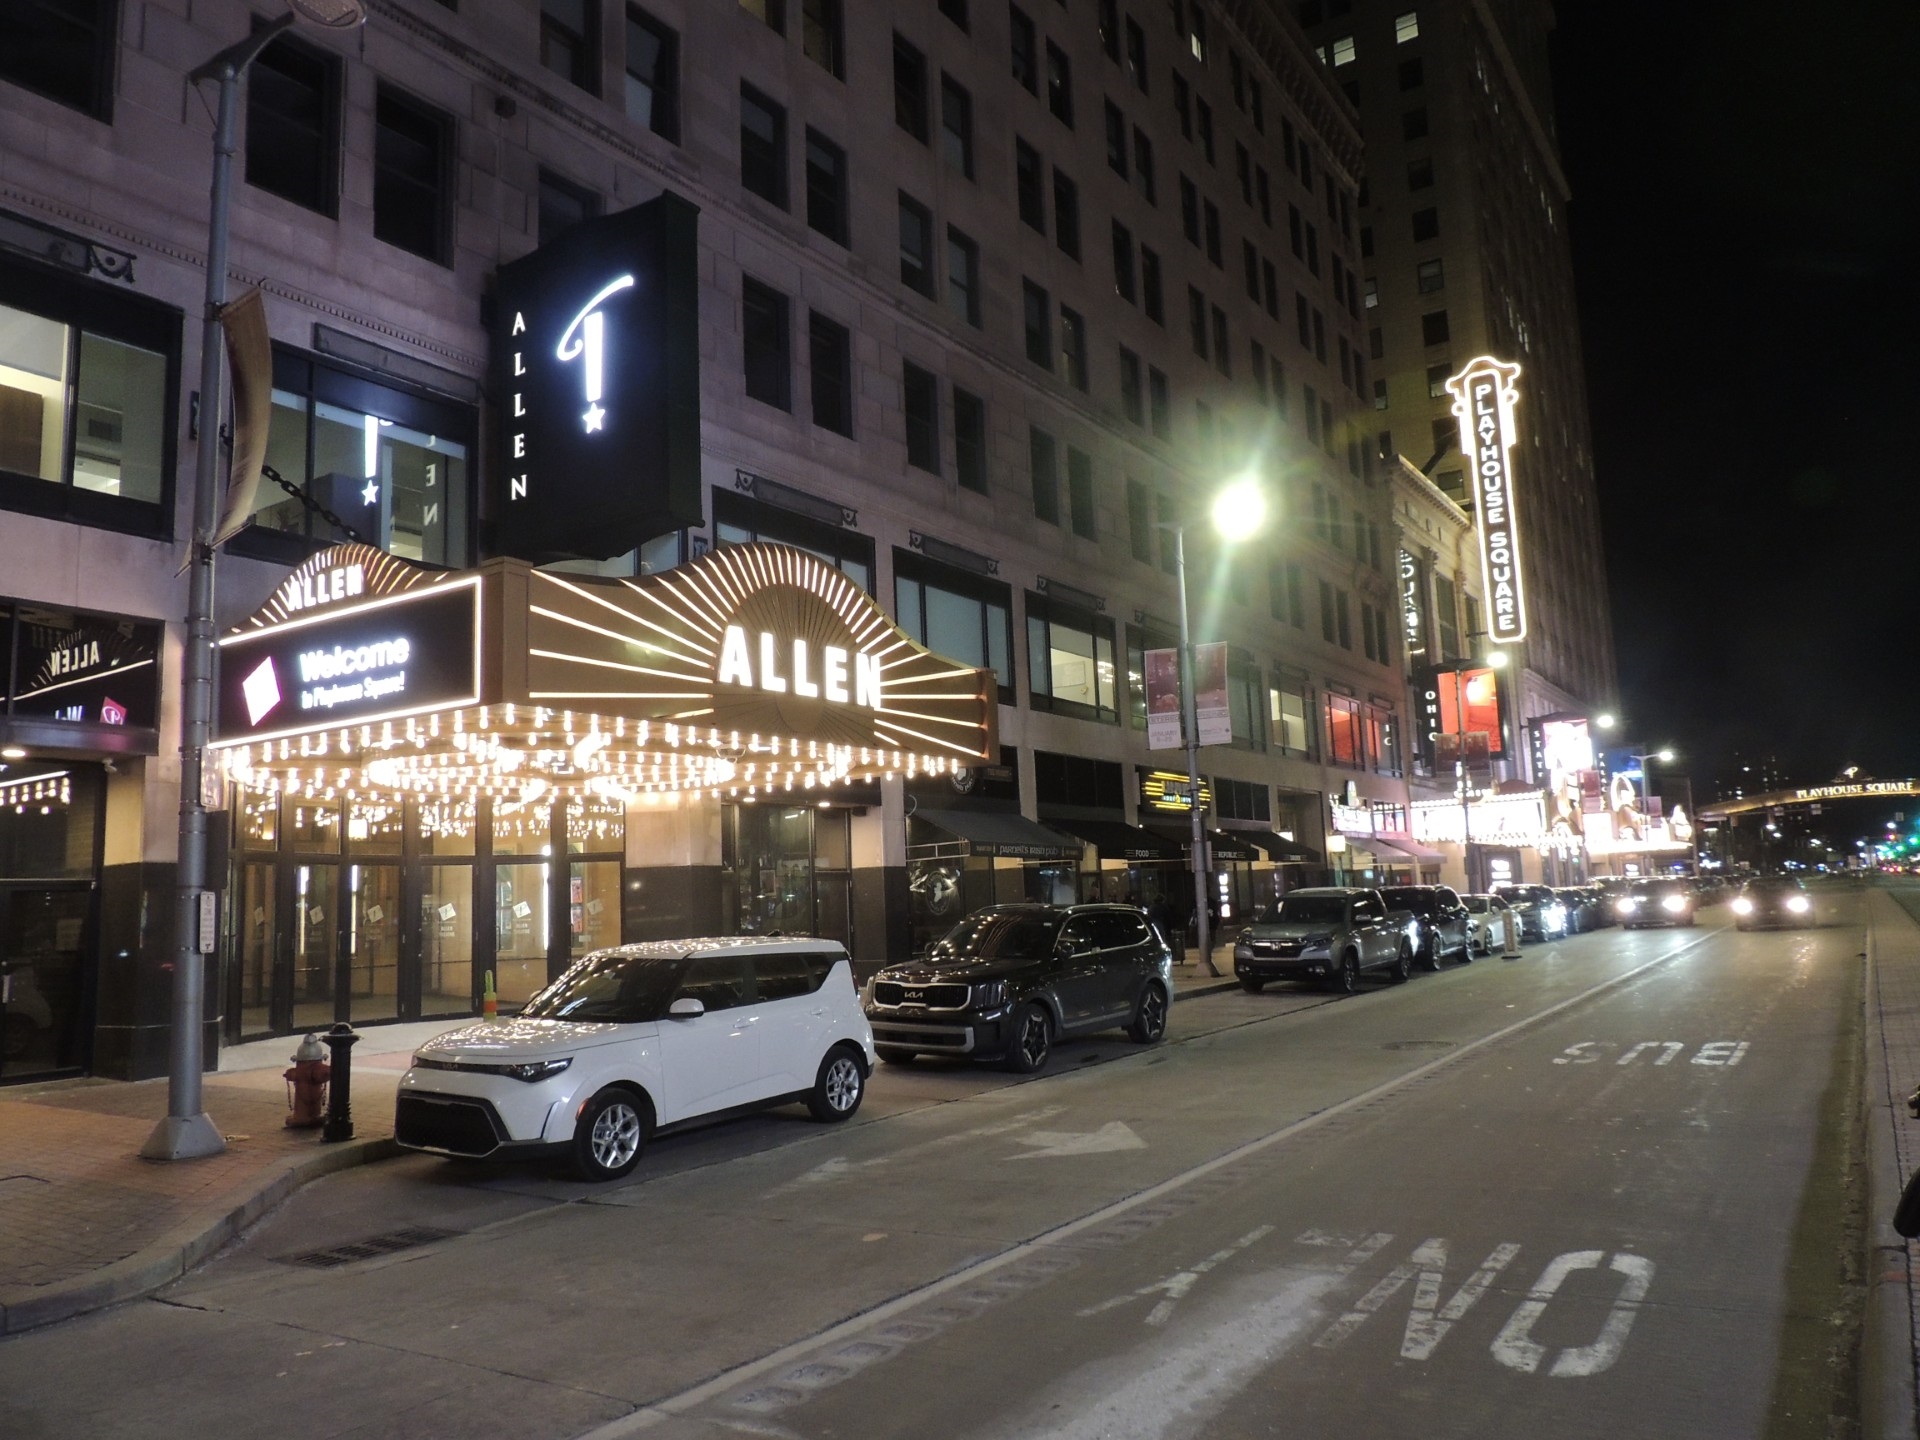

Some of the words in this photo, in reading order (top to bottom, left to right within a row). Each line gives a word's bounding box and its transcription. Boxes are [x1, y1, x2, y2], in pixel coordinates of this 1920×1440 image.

[510, 311, 527, 501] ALLEN
[1475, 384, 1505, 524] PLAYHOUSE
[286, 562, 363, 612] ALLEN
[1489, 534, 1516, 631] SQUARE
[299, 637, 410, 682] Welcome
[718, 624, 881, 711] ALLEN
[1796, 784, 1863, 799] PLAYHOUSE
[1866, 782, 1913, 792] SQUARE
[1135, 849, 1149, 858] FOOD
